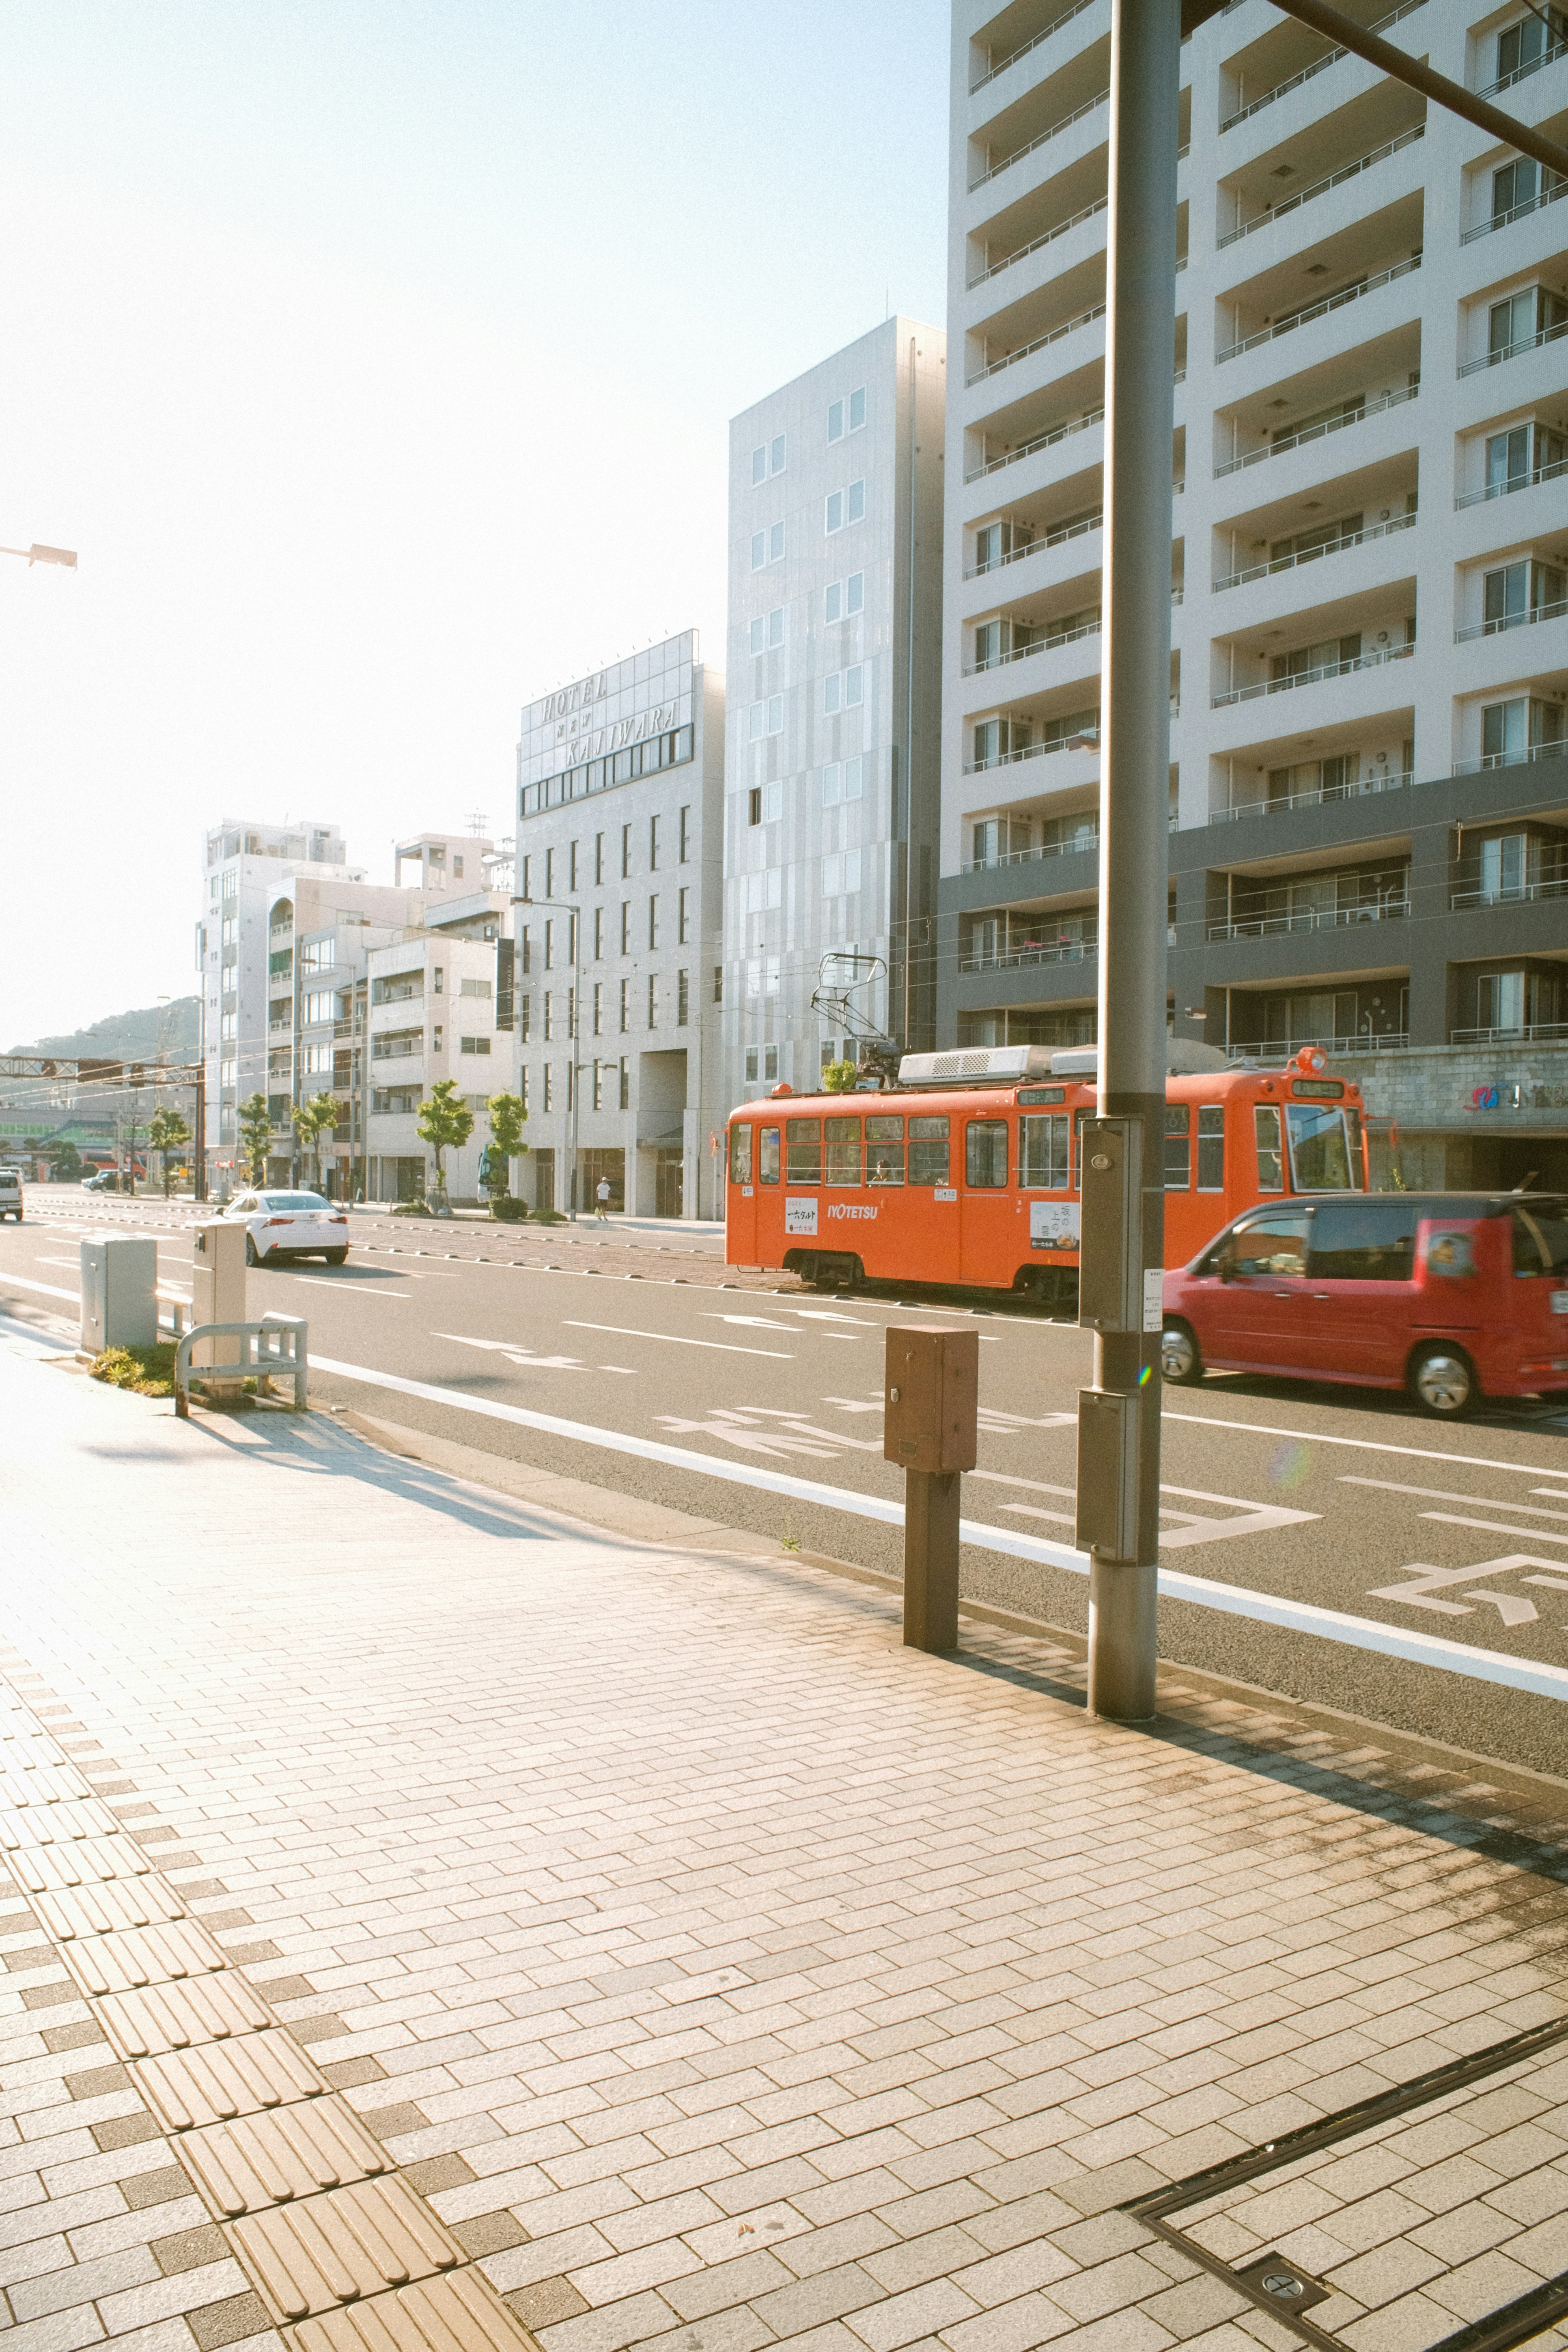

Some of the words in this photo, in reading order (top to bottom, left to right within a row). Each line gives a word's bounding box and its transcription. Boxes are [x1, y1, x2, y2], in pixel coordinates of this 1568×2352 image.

[541, 674, 607, 723] HOTEL
[556, 712, 592, 738] NEW
[567, 701, 677, 766] KAJIWARA
[788, 1210, 815, 1221] 一六タルト
[827, 1204, 878, 1219] IYOTETSU
